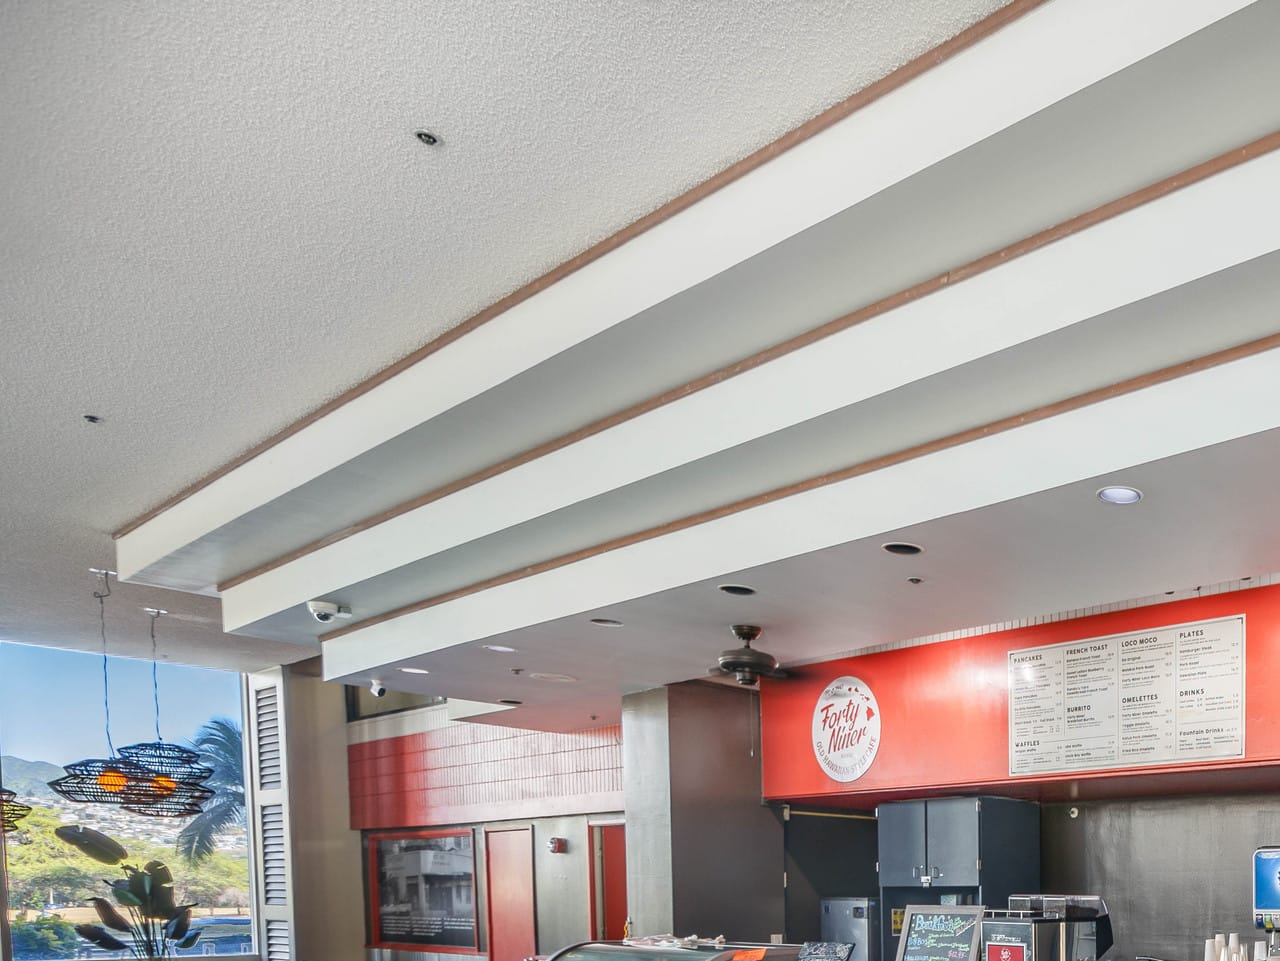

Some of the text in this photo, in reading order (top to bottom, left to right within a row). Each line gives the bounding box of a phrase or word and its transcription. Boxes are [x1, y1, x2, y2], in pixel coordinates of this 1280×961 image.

[1179, 629, 1204, 639] PLATES
[1121, 640, 1138, 648] LOCO
[1140, 636, 1158, 645] MOCO
[1066, 644, 1108, 656] FRENCH TOAST
[1013, 654, 1042, 664] PANCAKES
[1179, 688, 1205, 697] DRINKS
[1121, 694, 1158, 704] OMELETTES
[1066, 705, 1091, 713] BURRITO
[820, 699, 860, 732] Forty
[1179, 729, 1204, 737] Fountain
[827, 726, 867, 755] Niner
[1014, 740, 1040, 748] WAFFLES
